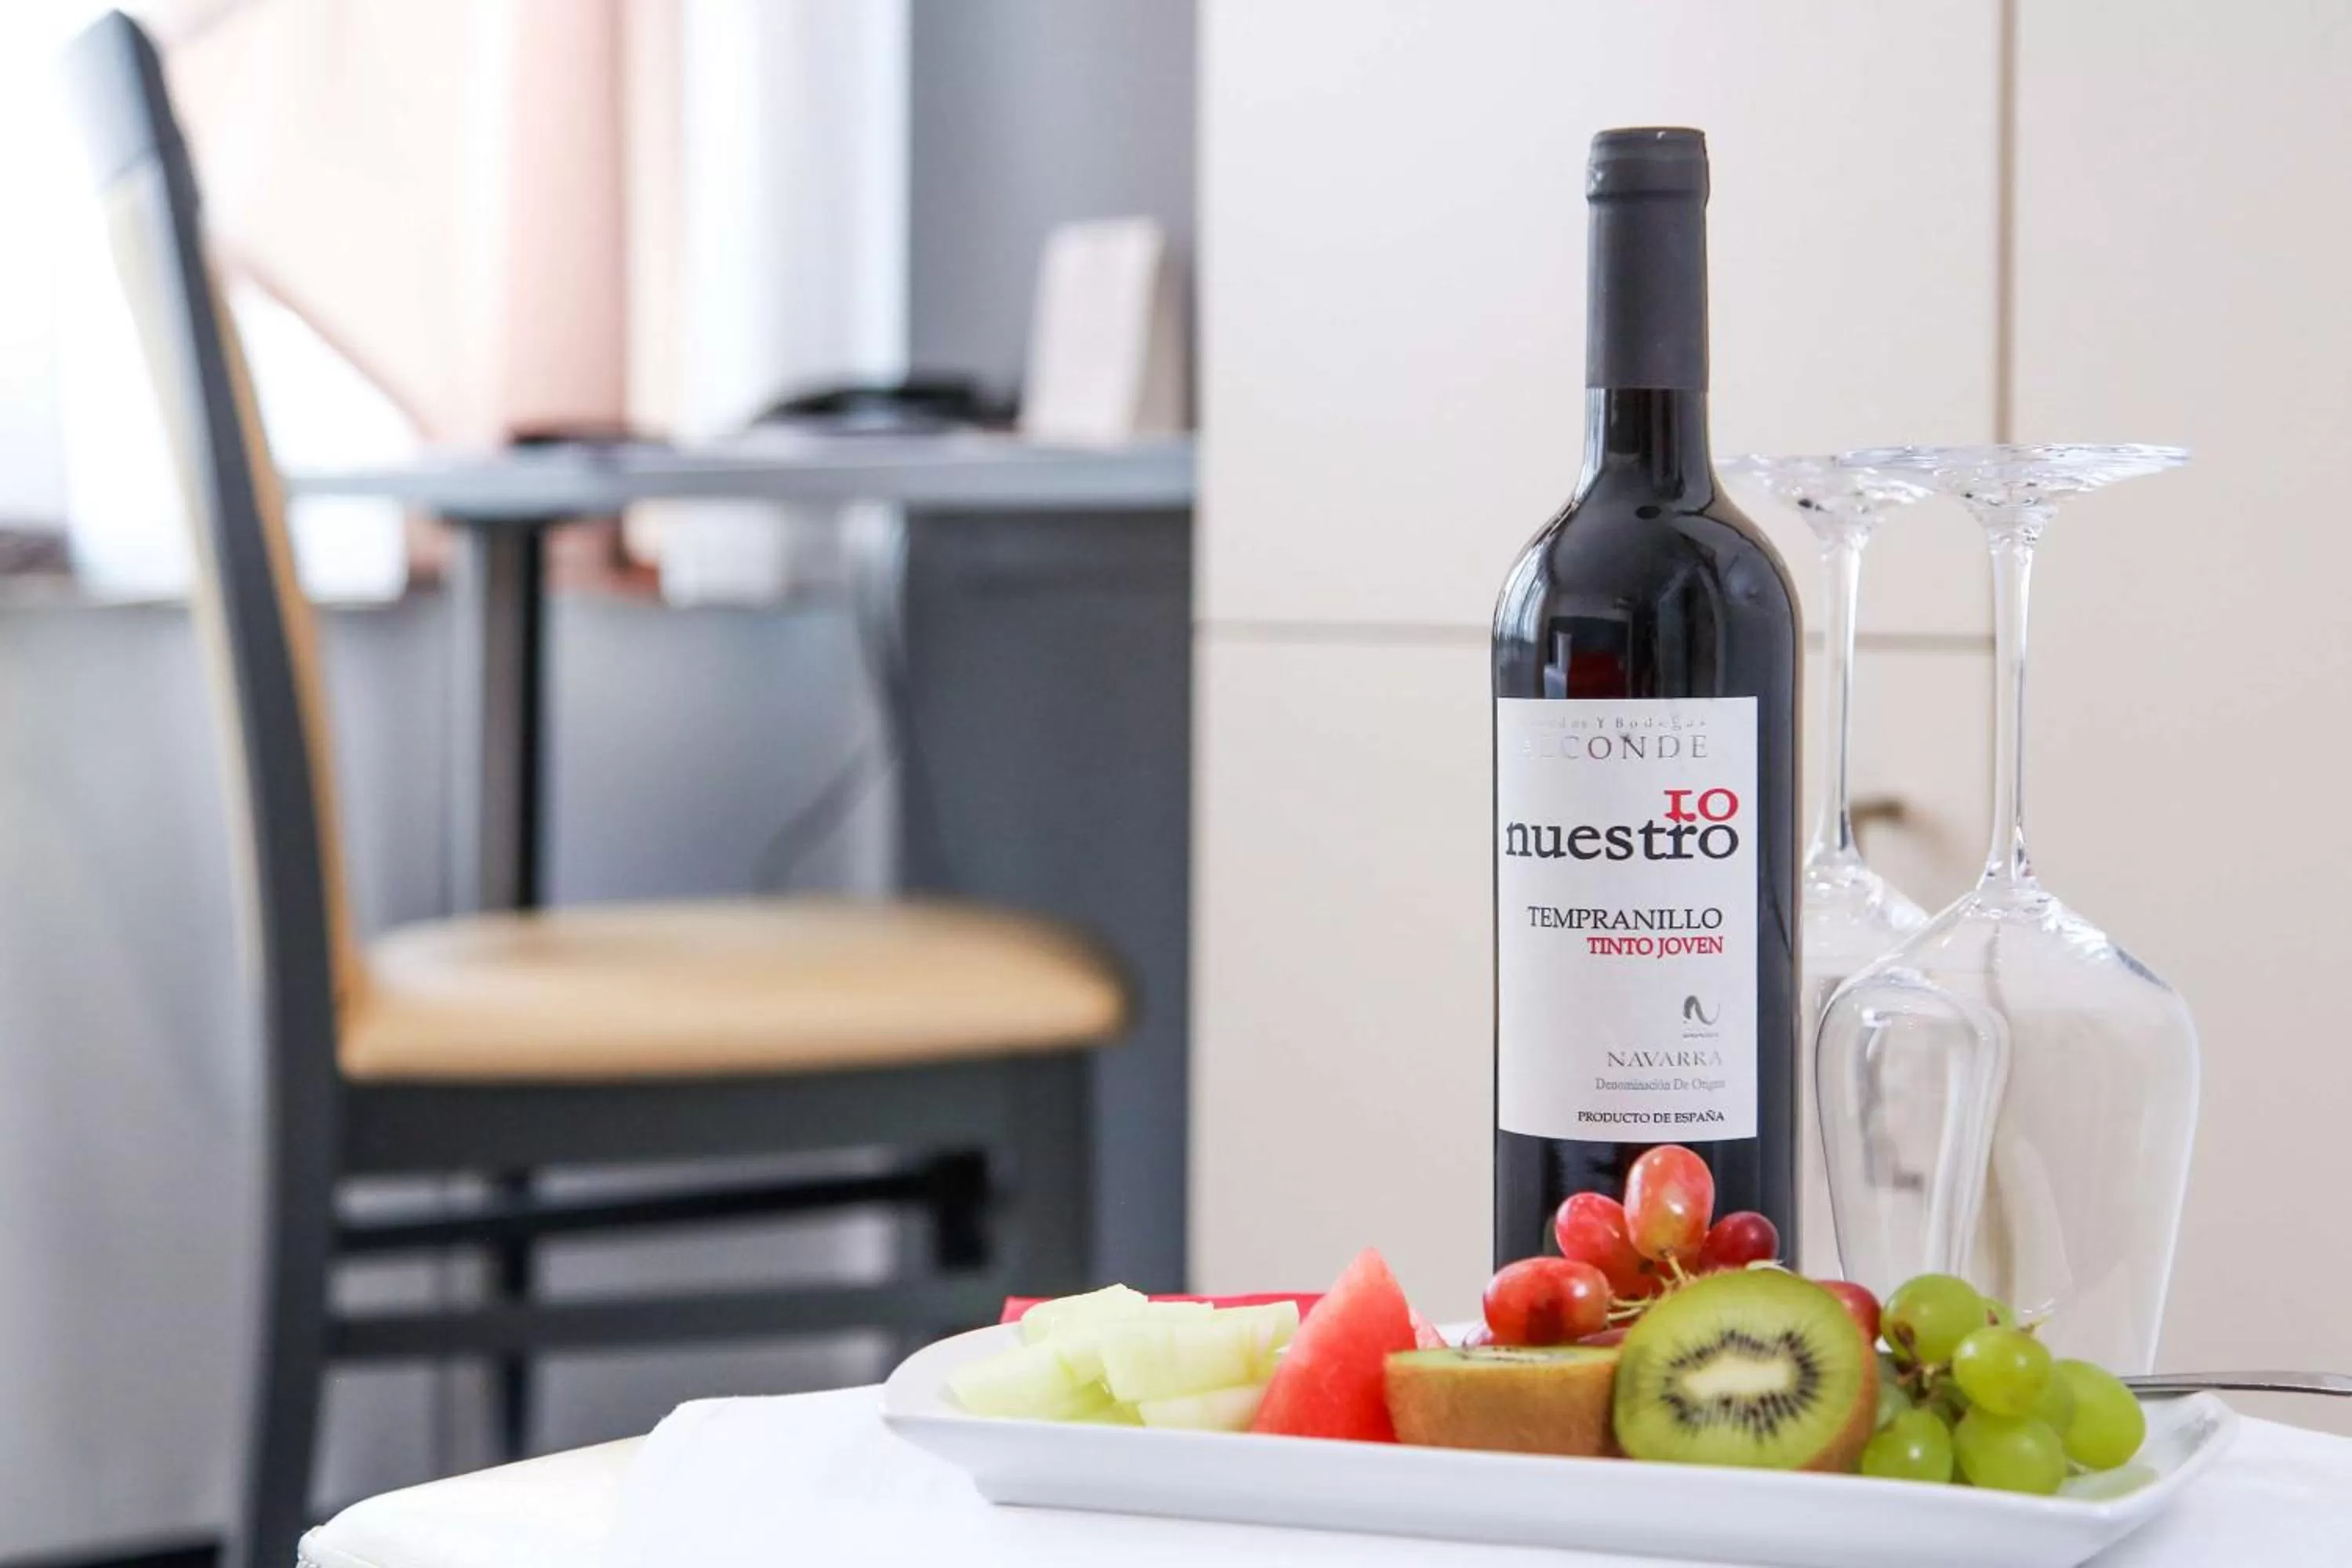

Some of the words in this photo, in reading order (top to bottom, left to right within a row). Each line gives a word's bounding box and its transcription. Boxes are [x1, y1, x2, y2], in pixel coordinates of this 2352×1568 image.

[1519, 734, 1708, 760] CONDE
[1505, 819, 1739, 860] nuestro
[1527, 906, 1722, 930] TEMPRANILLO
[1587, 937, 1653, 955] TINTO
[1657, 936, 1723, 958] JOVEN
[1607, 1051, 1722, 1067] NAVARRA
[1578, 1111, 1650, 1123] PRODUCTO
[1653, 1112, 1671, 1123] DE
[1675, 1110, 1725, 1123] ESPAÑA
